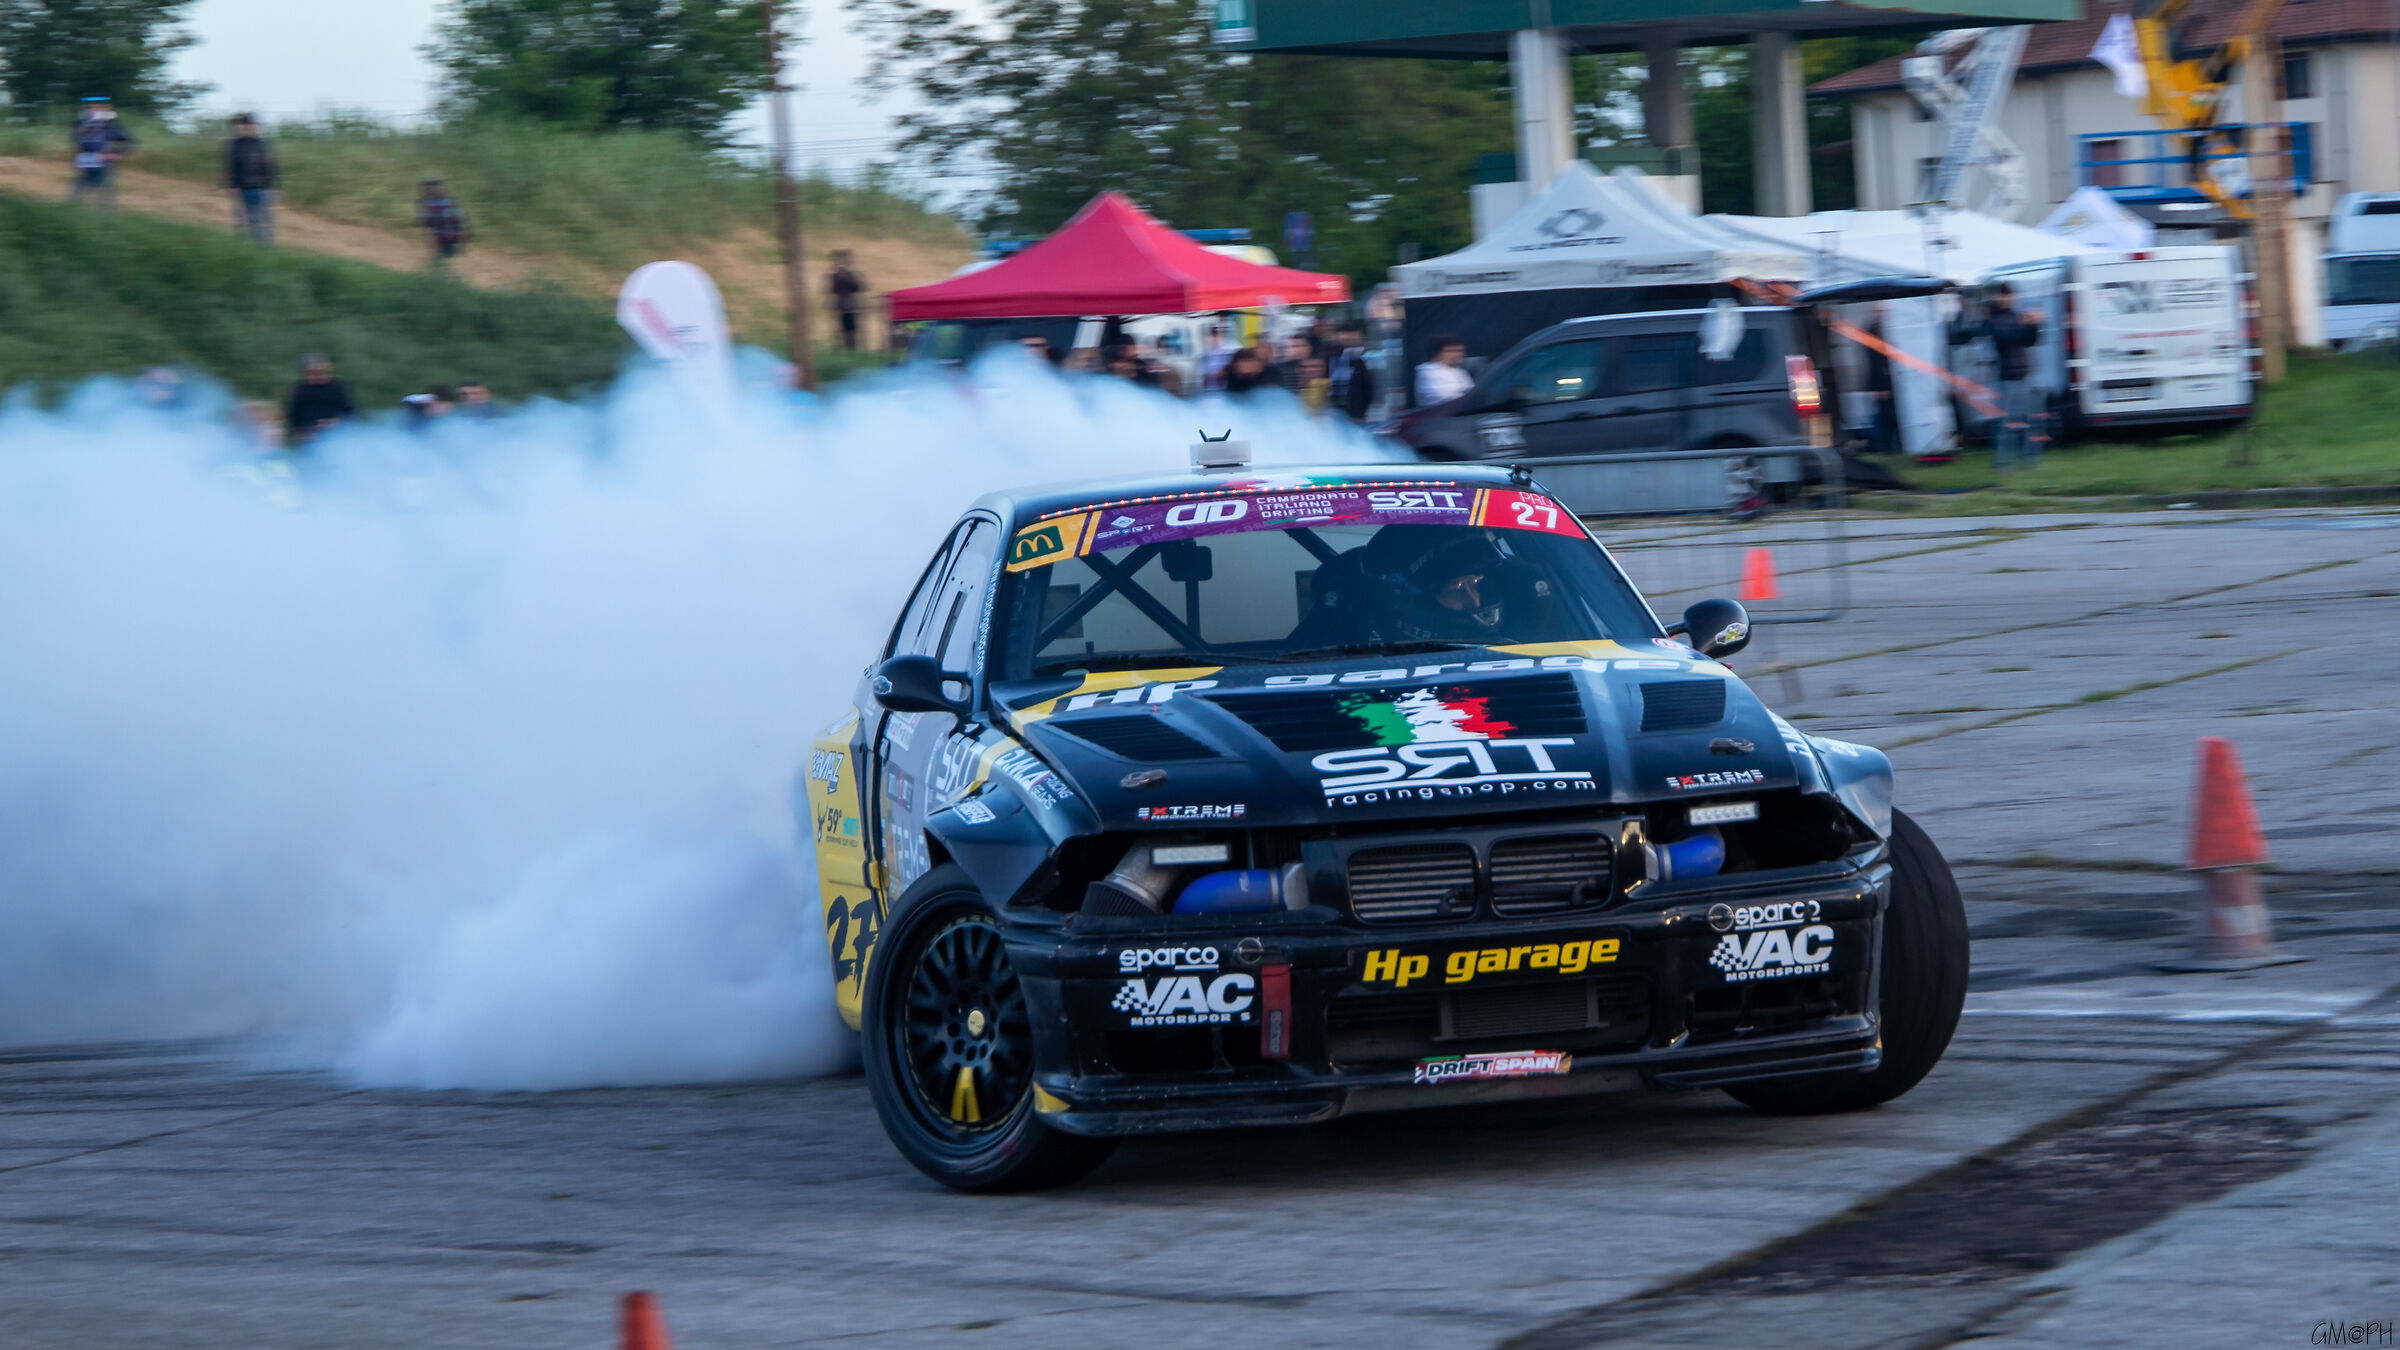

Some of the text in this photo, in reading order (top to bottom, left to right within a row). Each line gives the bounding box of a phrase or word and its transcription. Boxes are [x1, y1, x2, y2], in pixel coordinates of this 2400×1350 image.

[1256, 492, 1359, 504] CAMPIONATO
[1258, 500, 1332, 511] ITALIANO
[1261, 507, 1335, 518] DRIFTING
[1511, 501, 1558, 529] 27
[1263, 655, 1684, 687] garage
[1311, 737, 1576, 788] SRT
[1326, 779, 1597, 807] racingshop.com
[1665, 769, 1764, 790] EXTREME
[1138, 804, 1245, 820] EXTREME
[1735, 900, 1820, 930] sparco
[1119, 947, 1219, 973] sparco
[1720, 925, 1835, 971] VAC
[1363, 938, 1620, 987] Hp garage
[1725, 963, 1830, 982] MOTORSPORTS
[1125, 973, 1255, 1016] VAC
[1131, 1012, 1250, 1026] MOTORSPORS
